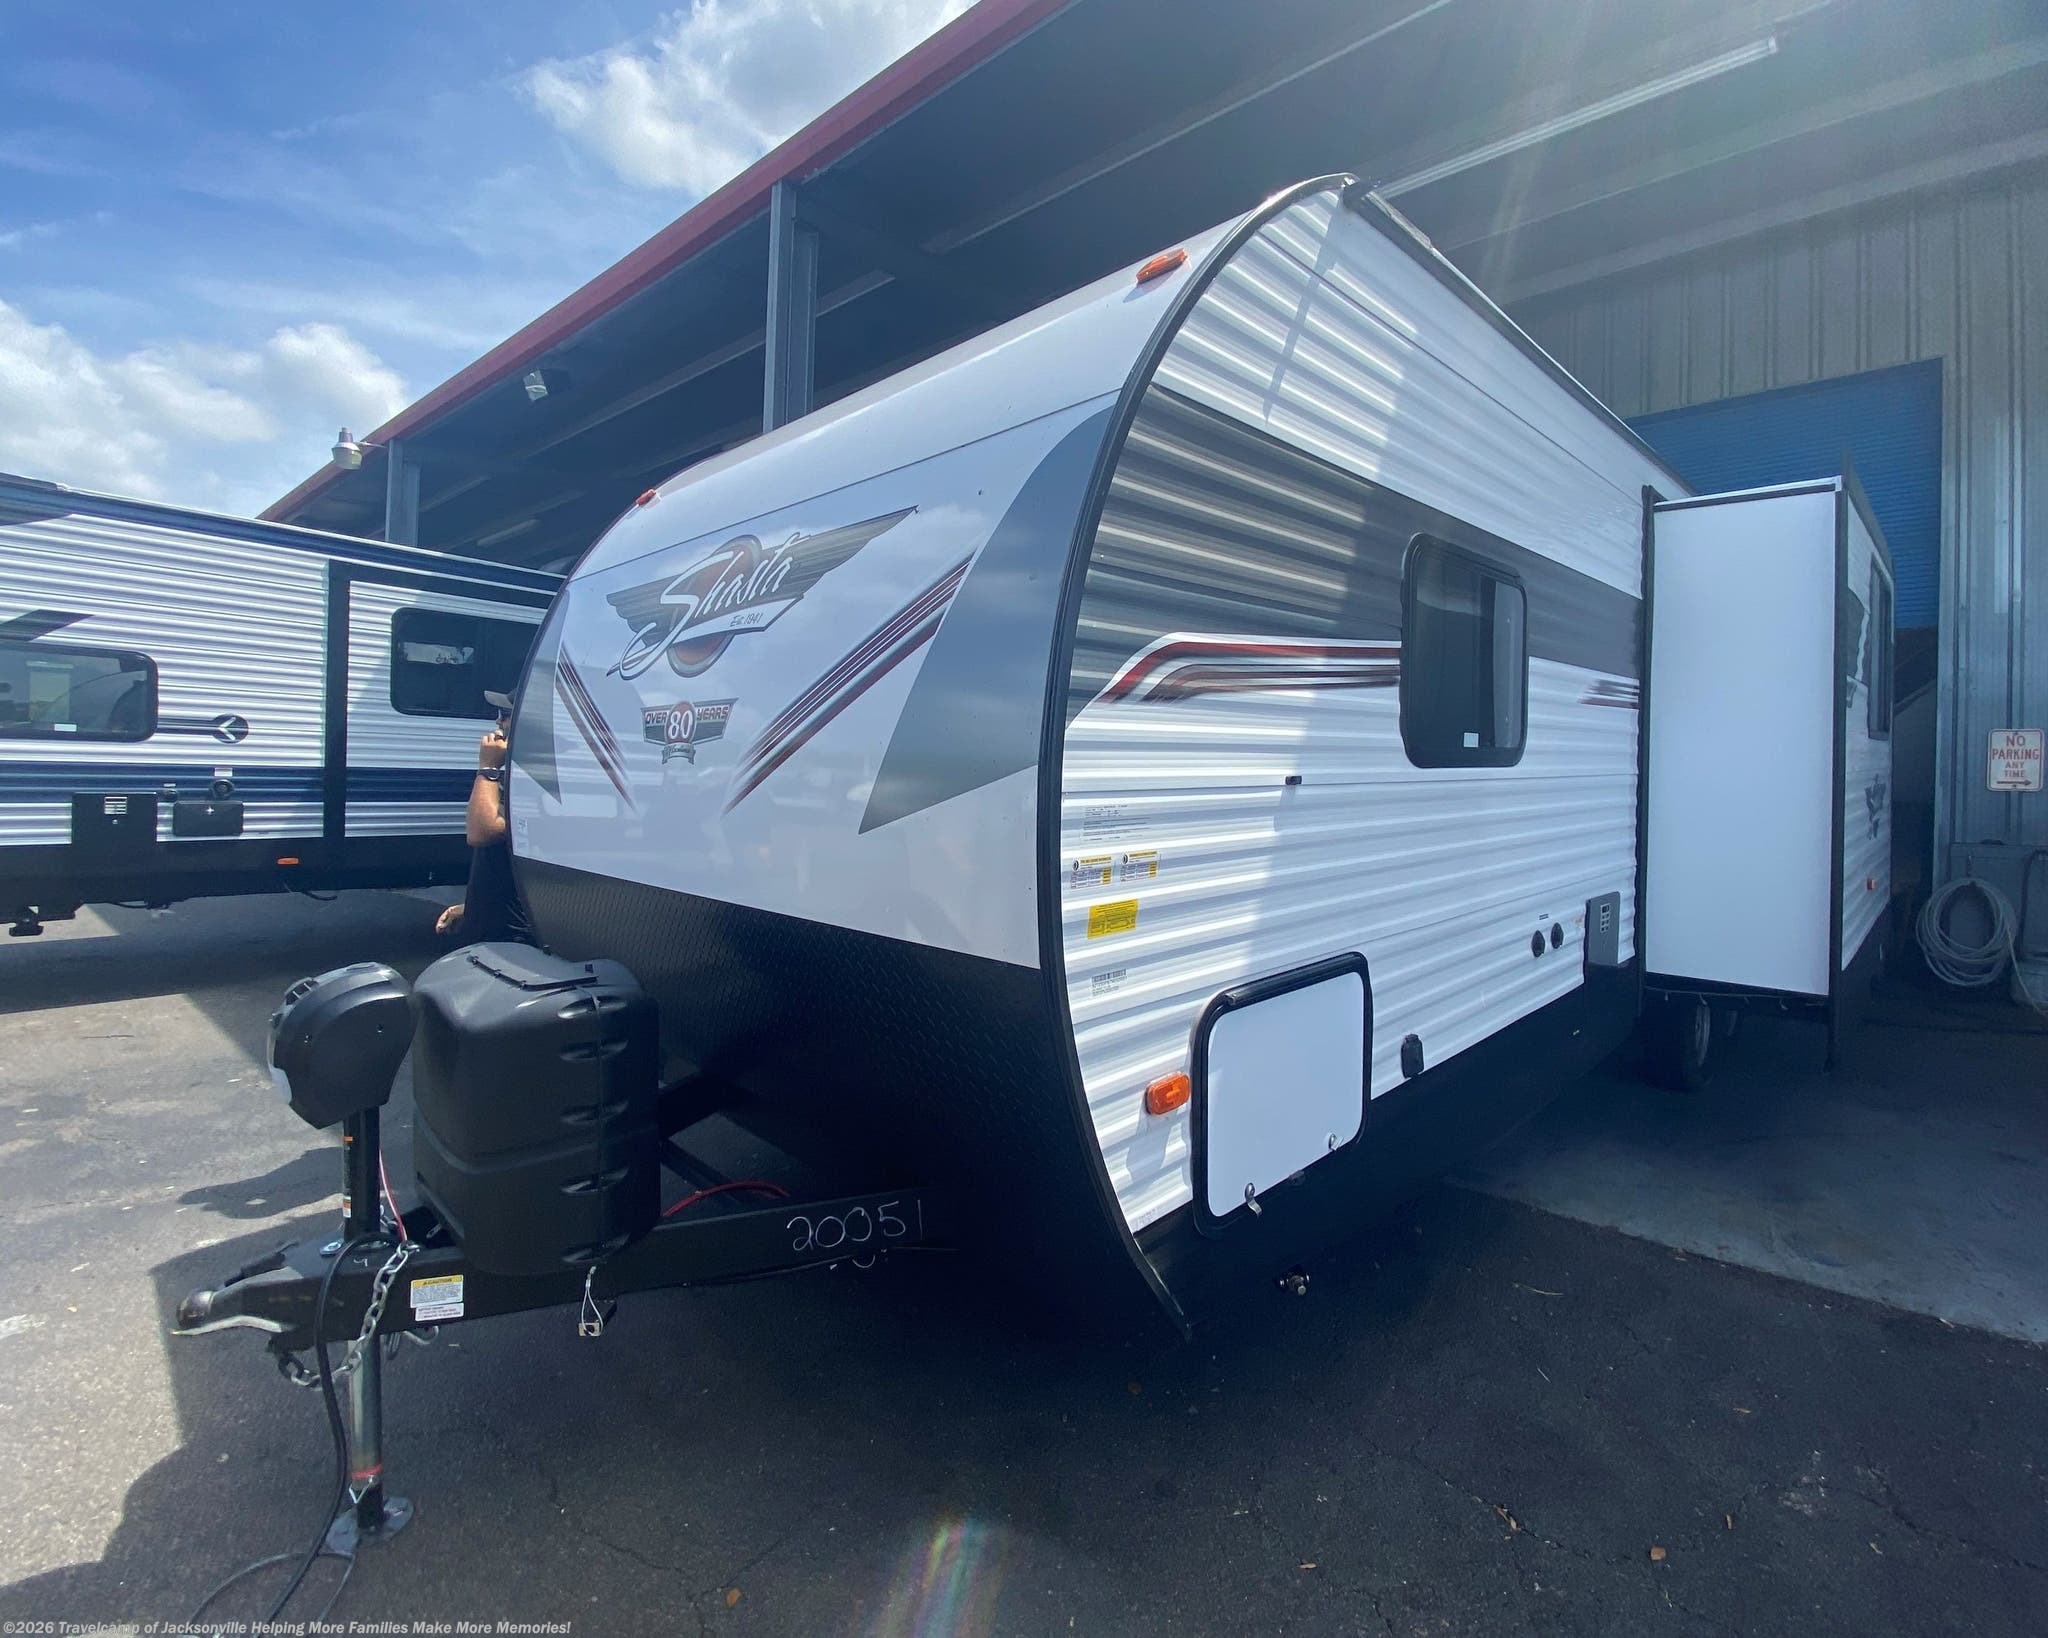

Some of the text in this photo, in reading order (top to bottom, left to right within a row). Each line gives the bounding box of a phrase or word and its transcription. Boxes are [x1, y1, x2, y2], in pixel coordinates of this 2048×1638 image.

[607, 532, 811, 680] Shasta
[645, 706, 728, 739] OVER 80 YEARS
[2006, 735, 2026, 747] NO
[1992, 748, 2040, 760] PARKING
[2005, 761, 2024, 769] ANY
[2005, 770, 2025, 778] TIME
